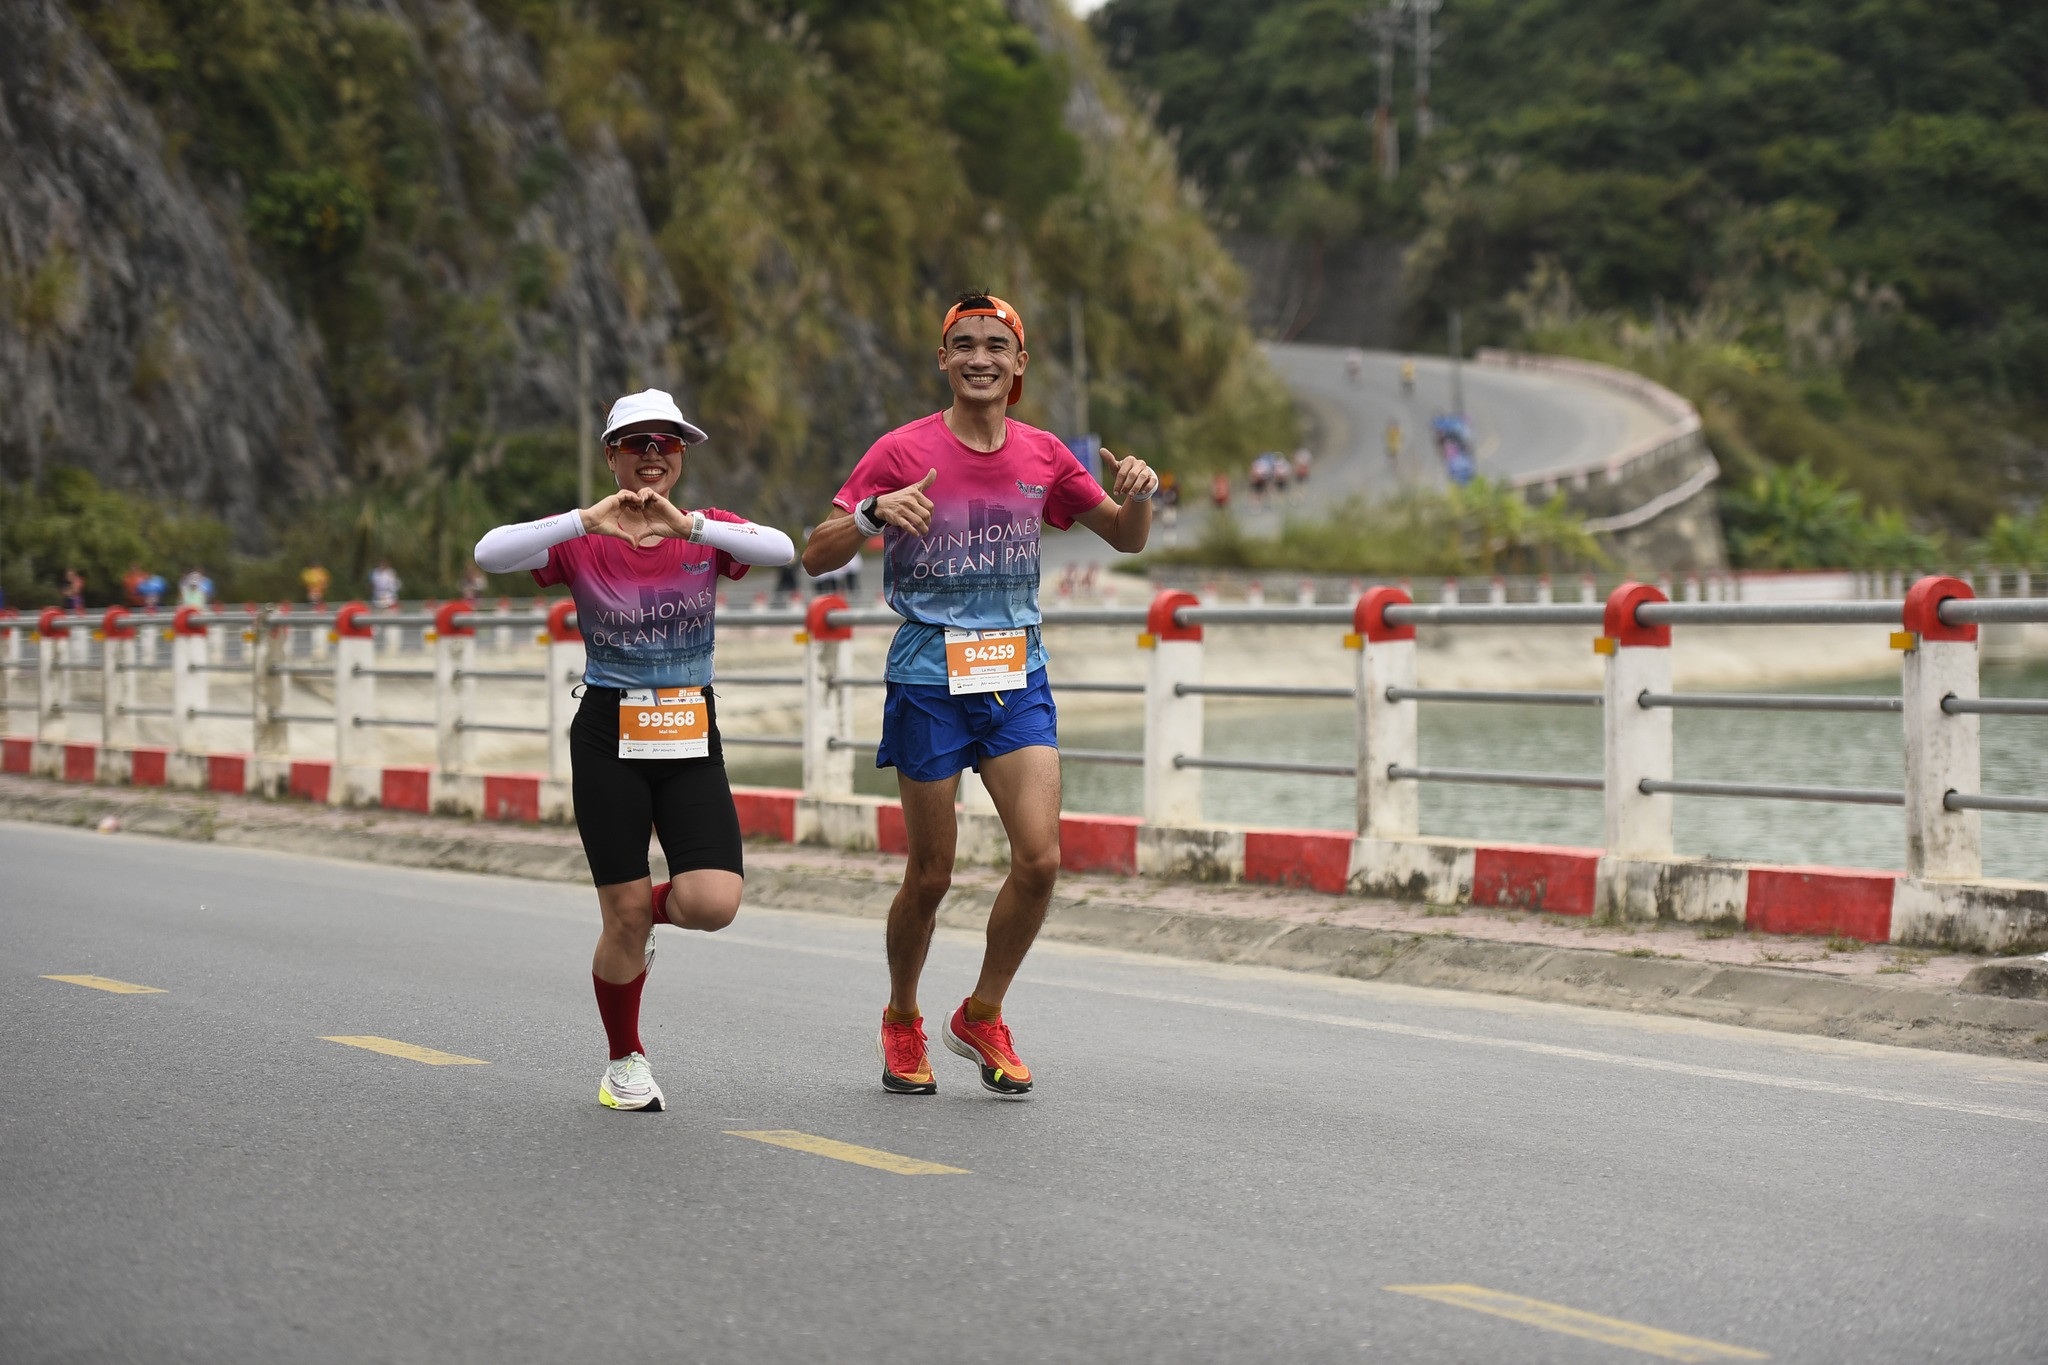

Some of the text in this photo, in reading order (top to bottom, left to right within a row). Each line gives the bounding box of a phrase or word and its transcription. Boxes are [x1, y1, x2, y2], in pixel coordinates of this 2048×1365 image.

[921, 517, 1040, 554] VINHOMES
[913, 550, 995, 580] OCEAN
[595, 587, 712, 626] VINHOMES
[593, 611, 715, 647] OCEAN PAR
[964, 644, 1015, 663] 94259
[637, 710, 696, 728] 99568
